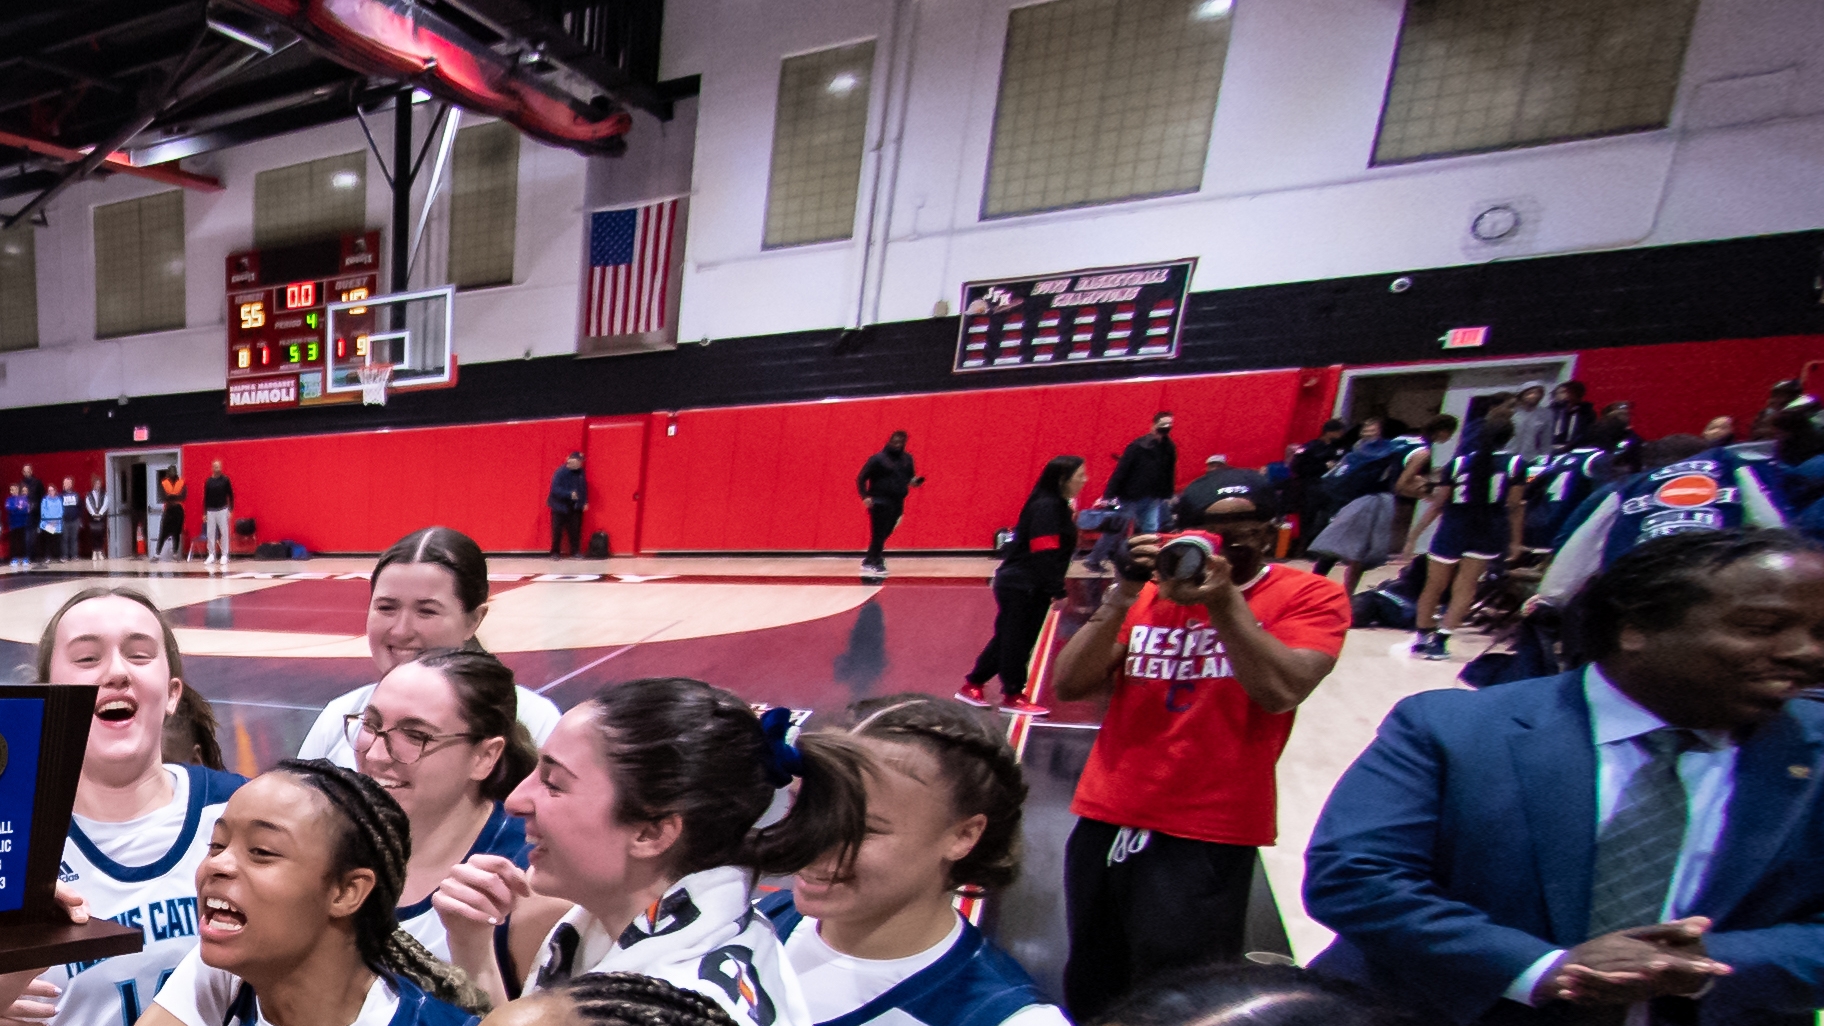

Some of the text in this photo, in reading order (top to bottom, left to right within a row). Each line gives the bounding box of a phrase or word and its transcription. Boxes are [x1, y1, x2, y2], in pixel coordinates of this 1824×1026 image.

[286, 283, 314, 309] 0.0
[240, 302, 265, 329] 55
[306, 313, 318, 329] 4
[262, 346, 270, 365] 1
[289, 344, 300, 363] 5
[307, 341, 319, 361] 3
[1124, 656, 1234, 680] CLEVELAN
